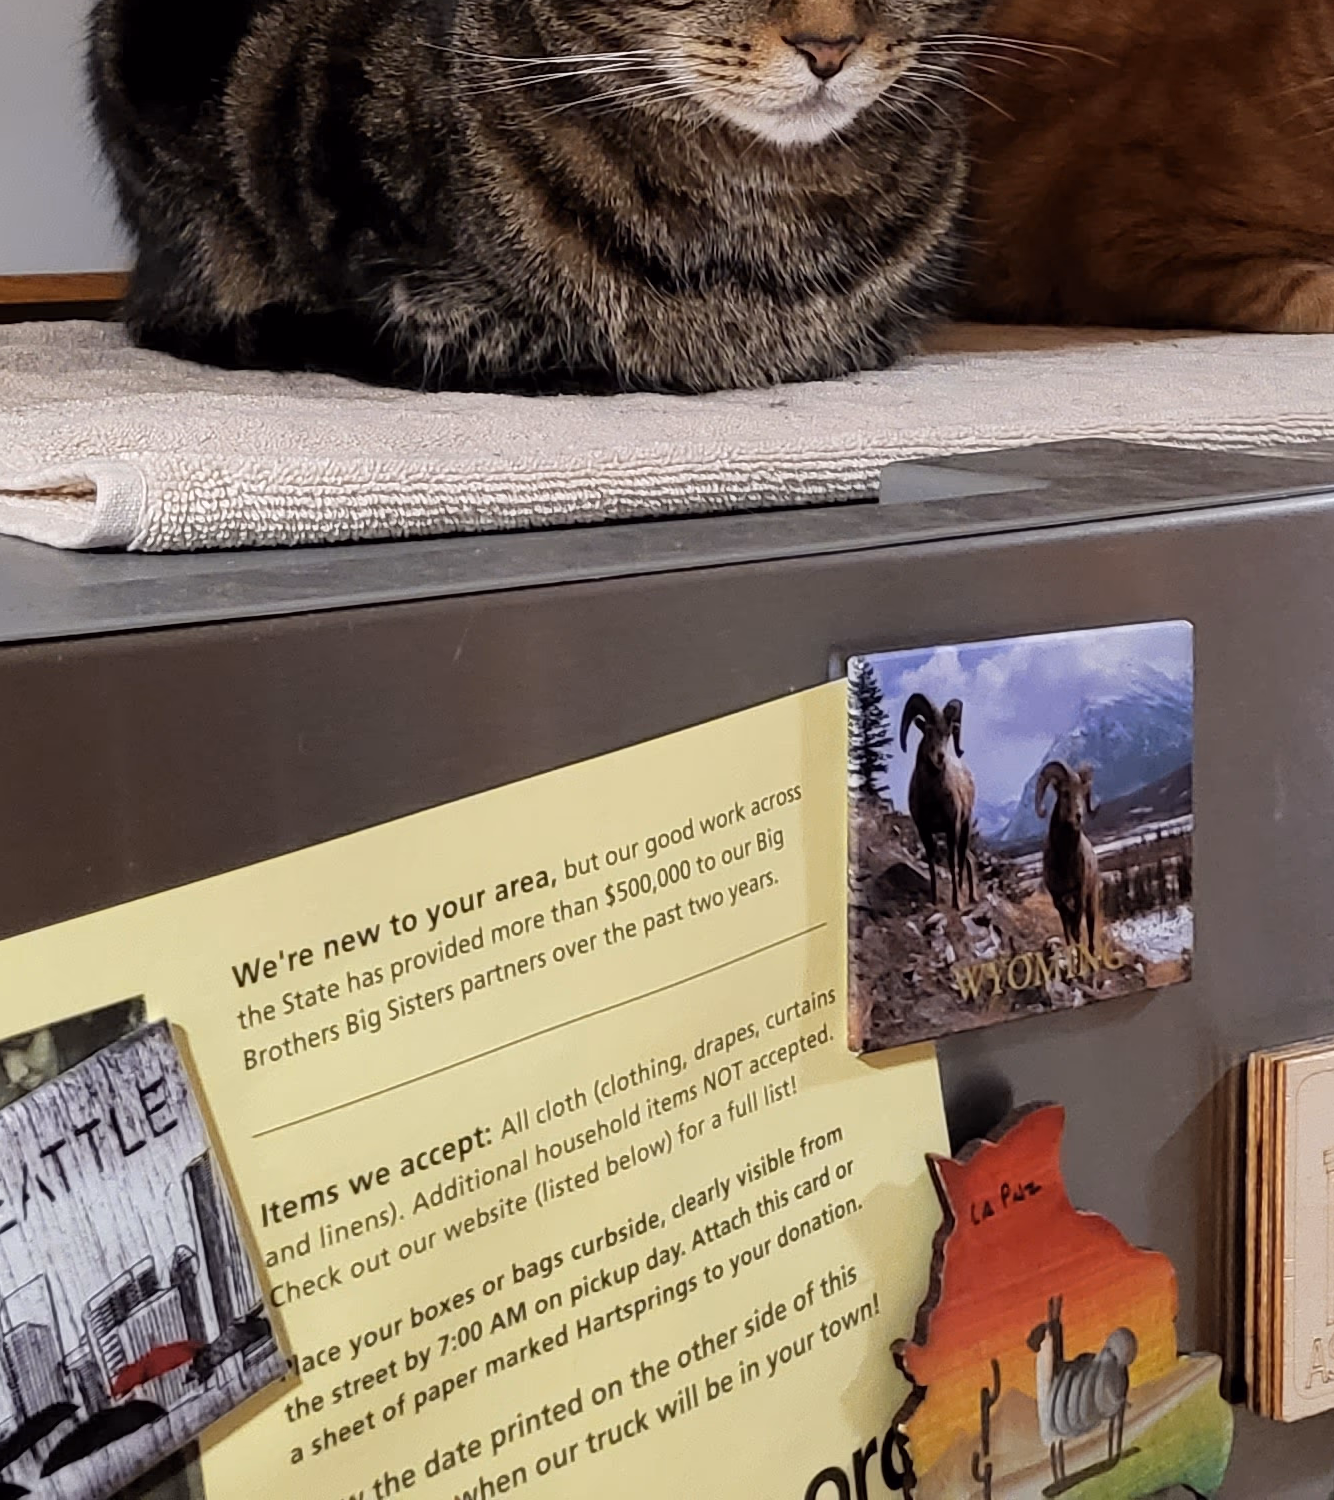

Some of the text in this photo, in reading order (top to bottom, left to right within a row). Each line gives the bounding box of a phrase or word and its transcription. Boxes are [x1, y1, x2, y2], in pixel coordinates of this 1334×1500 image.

[231, 785, 802, 989] We're new to your area, but our good work across
[236, 827, 784, 1030] the State has provided more than $500,000 to our Big
[243, 870, 779, 1071] Brothers Big Sisters partners over the past two years.
[951, 941, 1125, 1000] WYOMING
[260, 988, 836, 1228] Items we accept: All cloth (clothing, drapes, curtains
[266, 1022, 834, 1268] and linens). Additional household items NOT accepted.
[268, 1075, 797, 1308] Check out our website (listed below) for a full list!
[280, 1127, 844, 1383] lace your boxes or bags curbside, clearly visible from
[283, 1159, 854, 1423] the street by 7:00 AM on pickup day. Attach this card or
[290, 1198, 863, 1465] a sheet of paper marked Hartsprings to your donation.
[371, 1264, 857, 1500] the date printed on the other side of this
[535, 1442, 579, 1477] our
[584, 1408, 650, 1454] truck
[655, 1383, 699, 1424] will
[704, 1374, 734, 1402] be
[738, 1360, 761, 1385] in
[765, 1331, 815, 1379] your
[819, 1292, 880, 1343] town!
